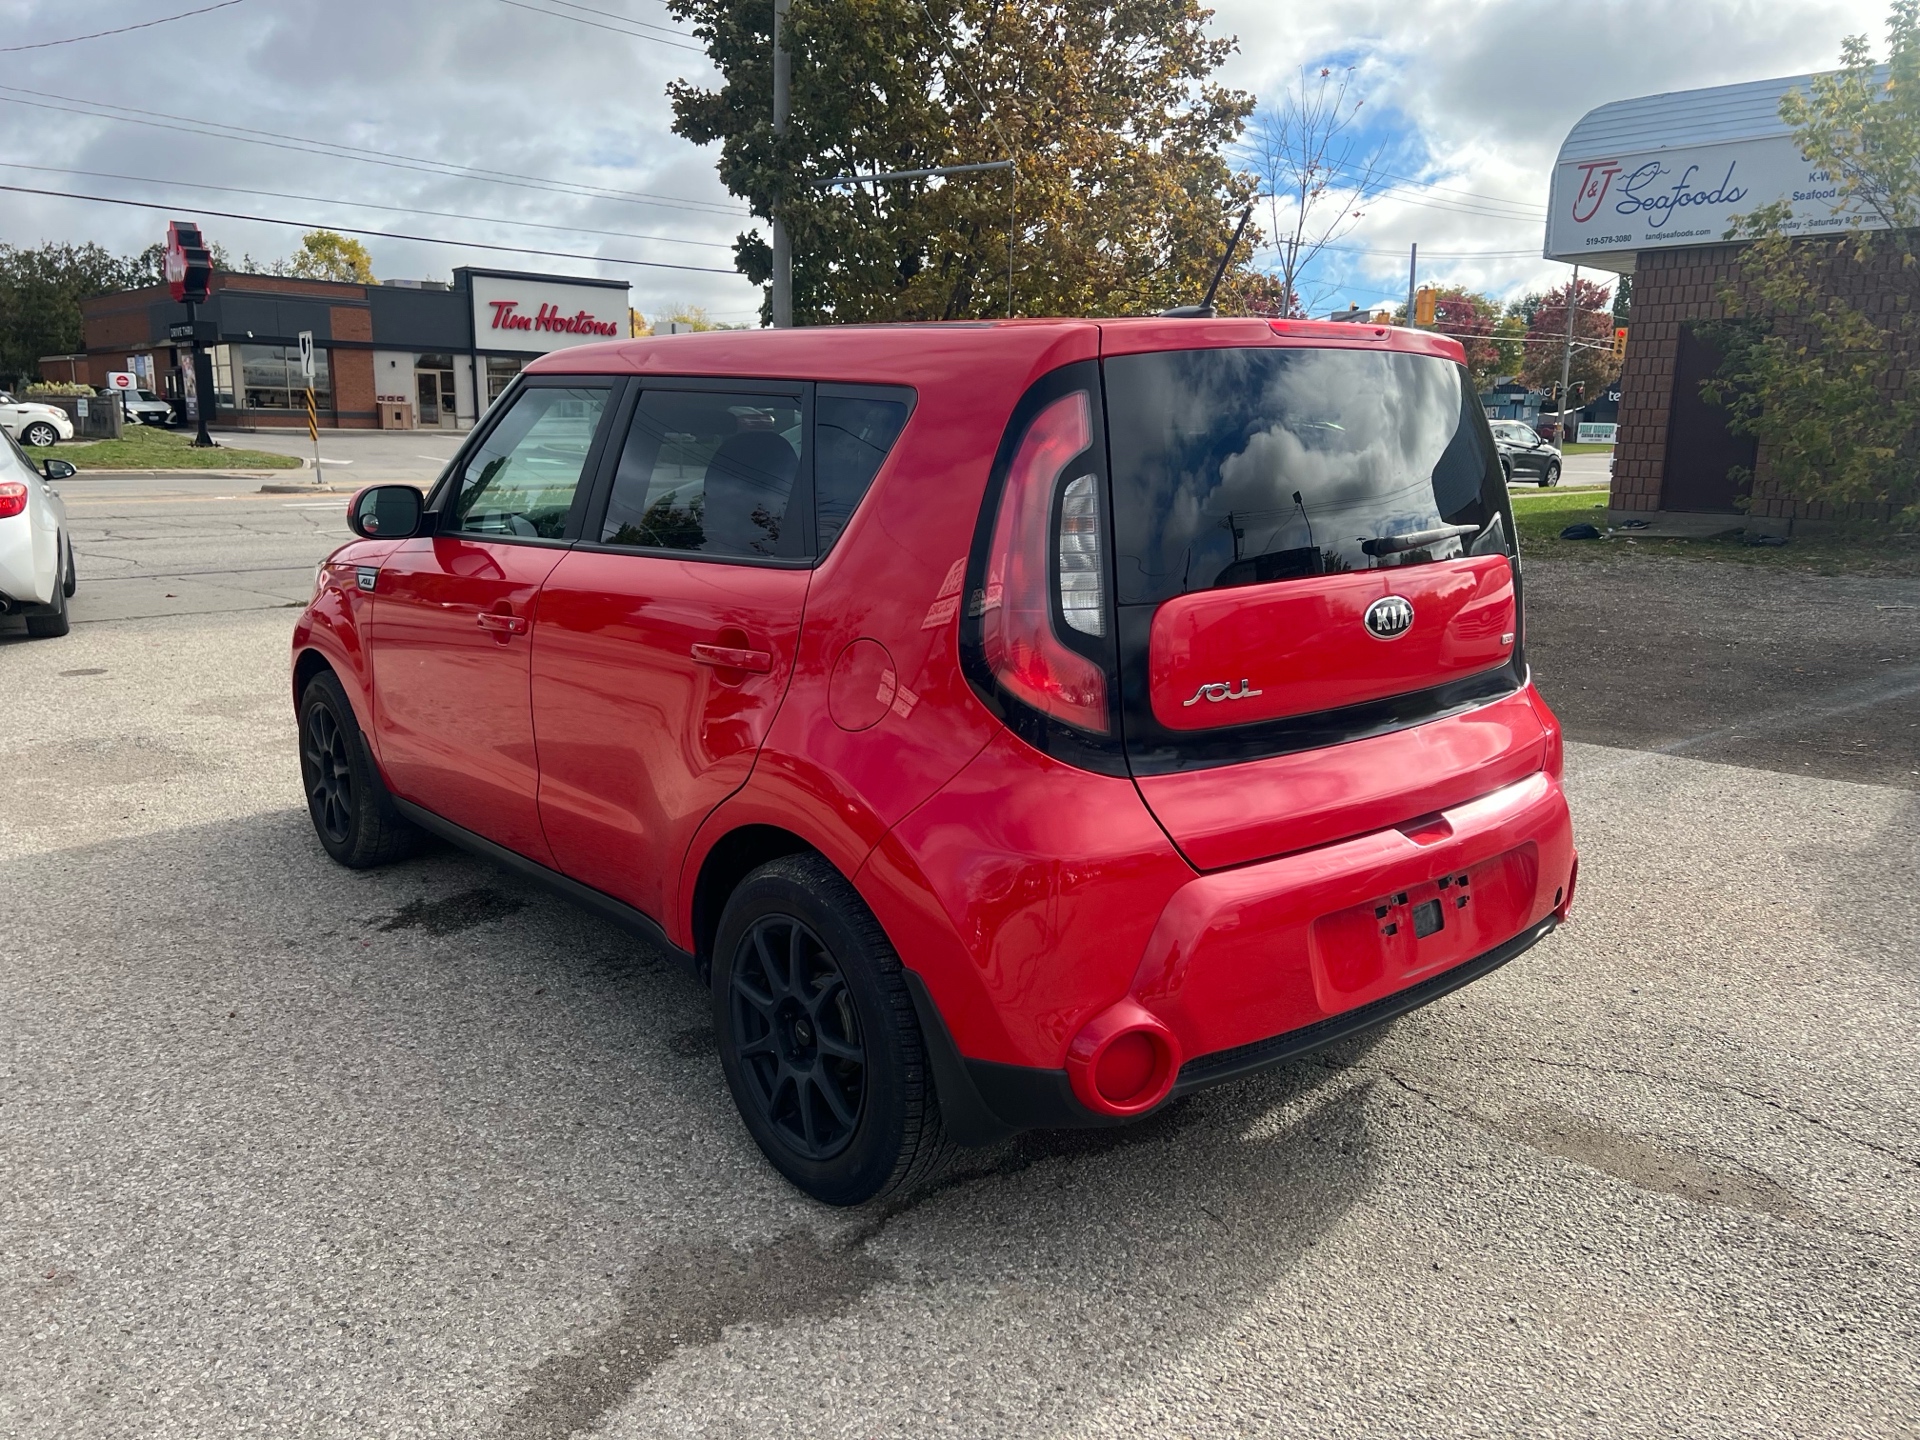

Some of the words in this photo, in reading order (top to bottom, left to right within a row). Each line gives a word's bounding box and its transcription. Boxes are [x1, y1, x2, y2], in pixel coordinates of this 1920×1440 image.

[1616, 160, 1748, 228] Seafoods
[1792, 188, 1836, 201] Seafood
[1808, 218, 1843, 228] Saturday
[1586, 234, 1632, 246] 519-578-3080
[1645, 228, 1711, 241] tandjseafoods.com
[489, 301, 532, 331] Tim
[535, 303, 617, 336] Hortons
[170, 327, 182, 338] DRIVE
[1374, 603, 1410, 631] KIA
